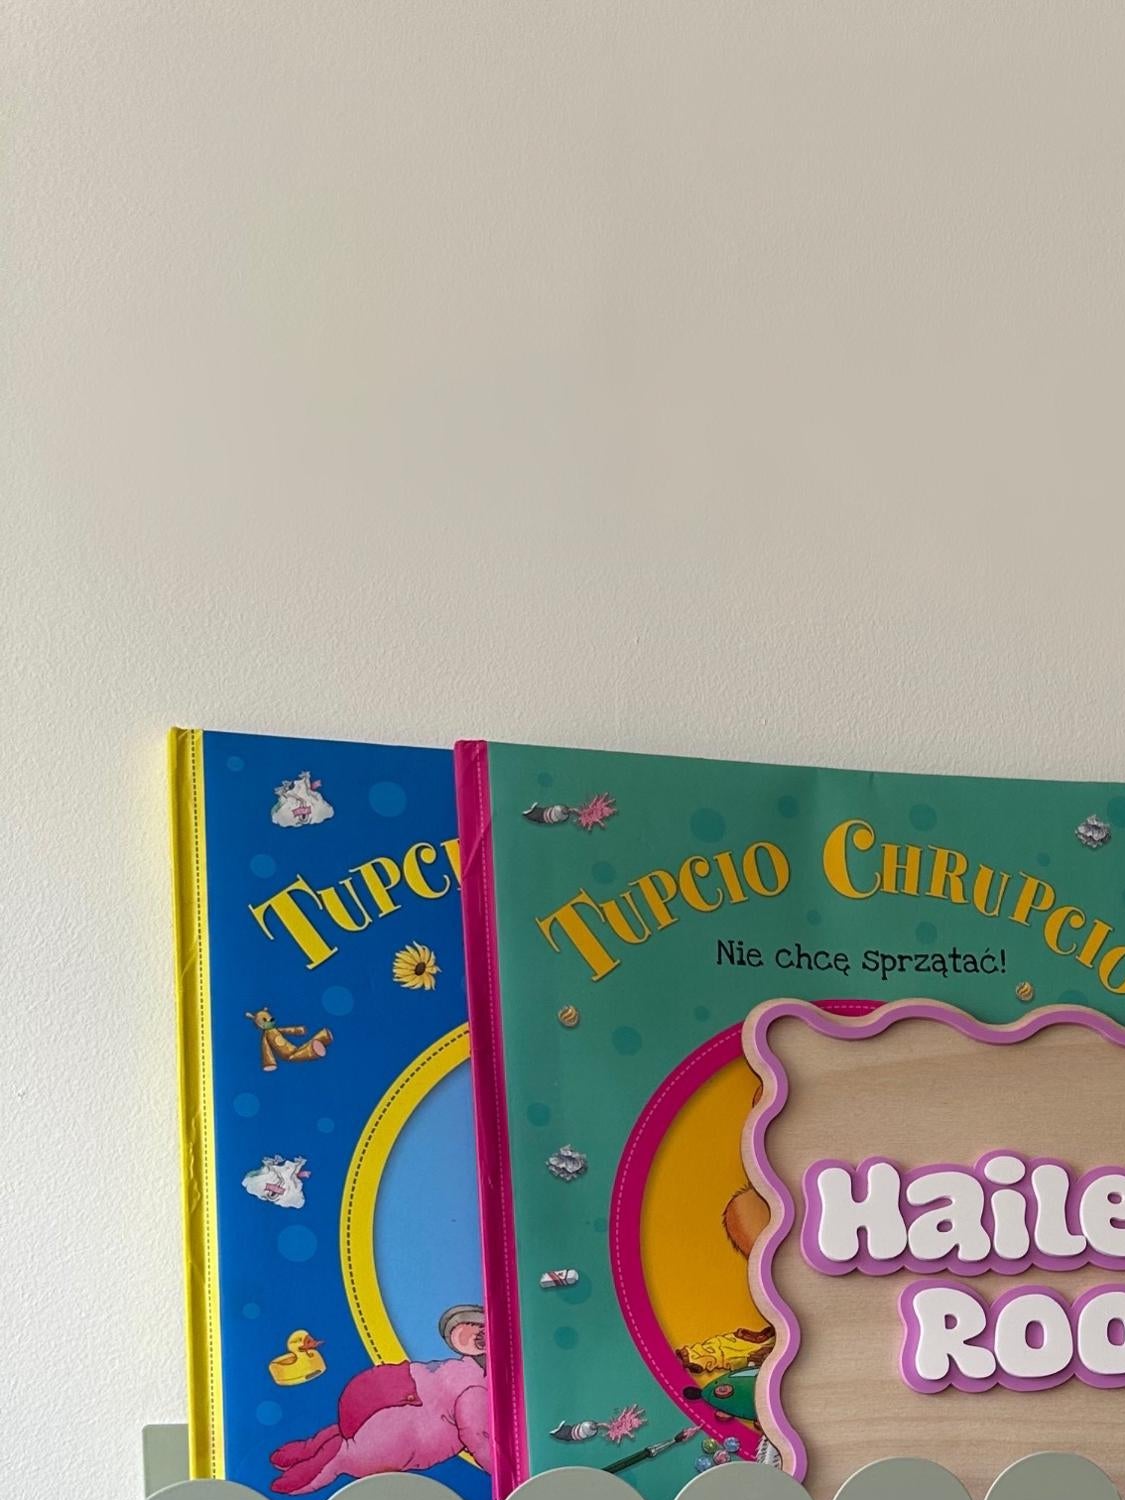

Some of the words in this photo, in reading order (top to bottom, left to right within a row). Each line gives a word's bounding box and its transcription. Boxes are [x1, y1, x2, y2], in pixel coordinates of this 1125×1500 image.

[535, 841, 790, 982] TUPCIO
[716, 940, 763, 967] Nie
[775, 943, 850, 976] chcę
[861, 947, 1007, 980] sprzątać!
